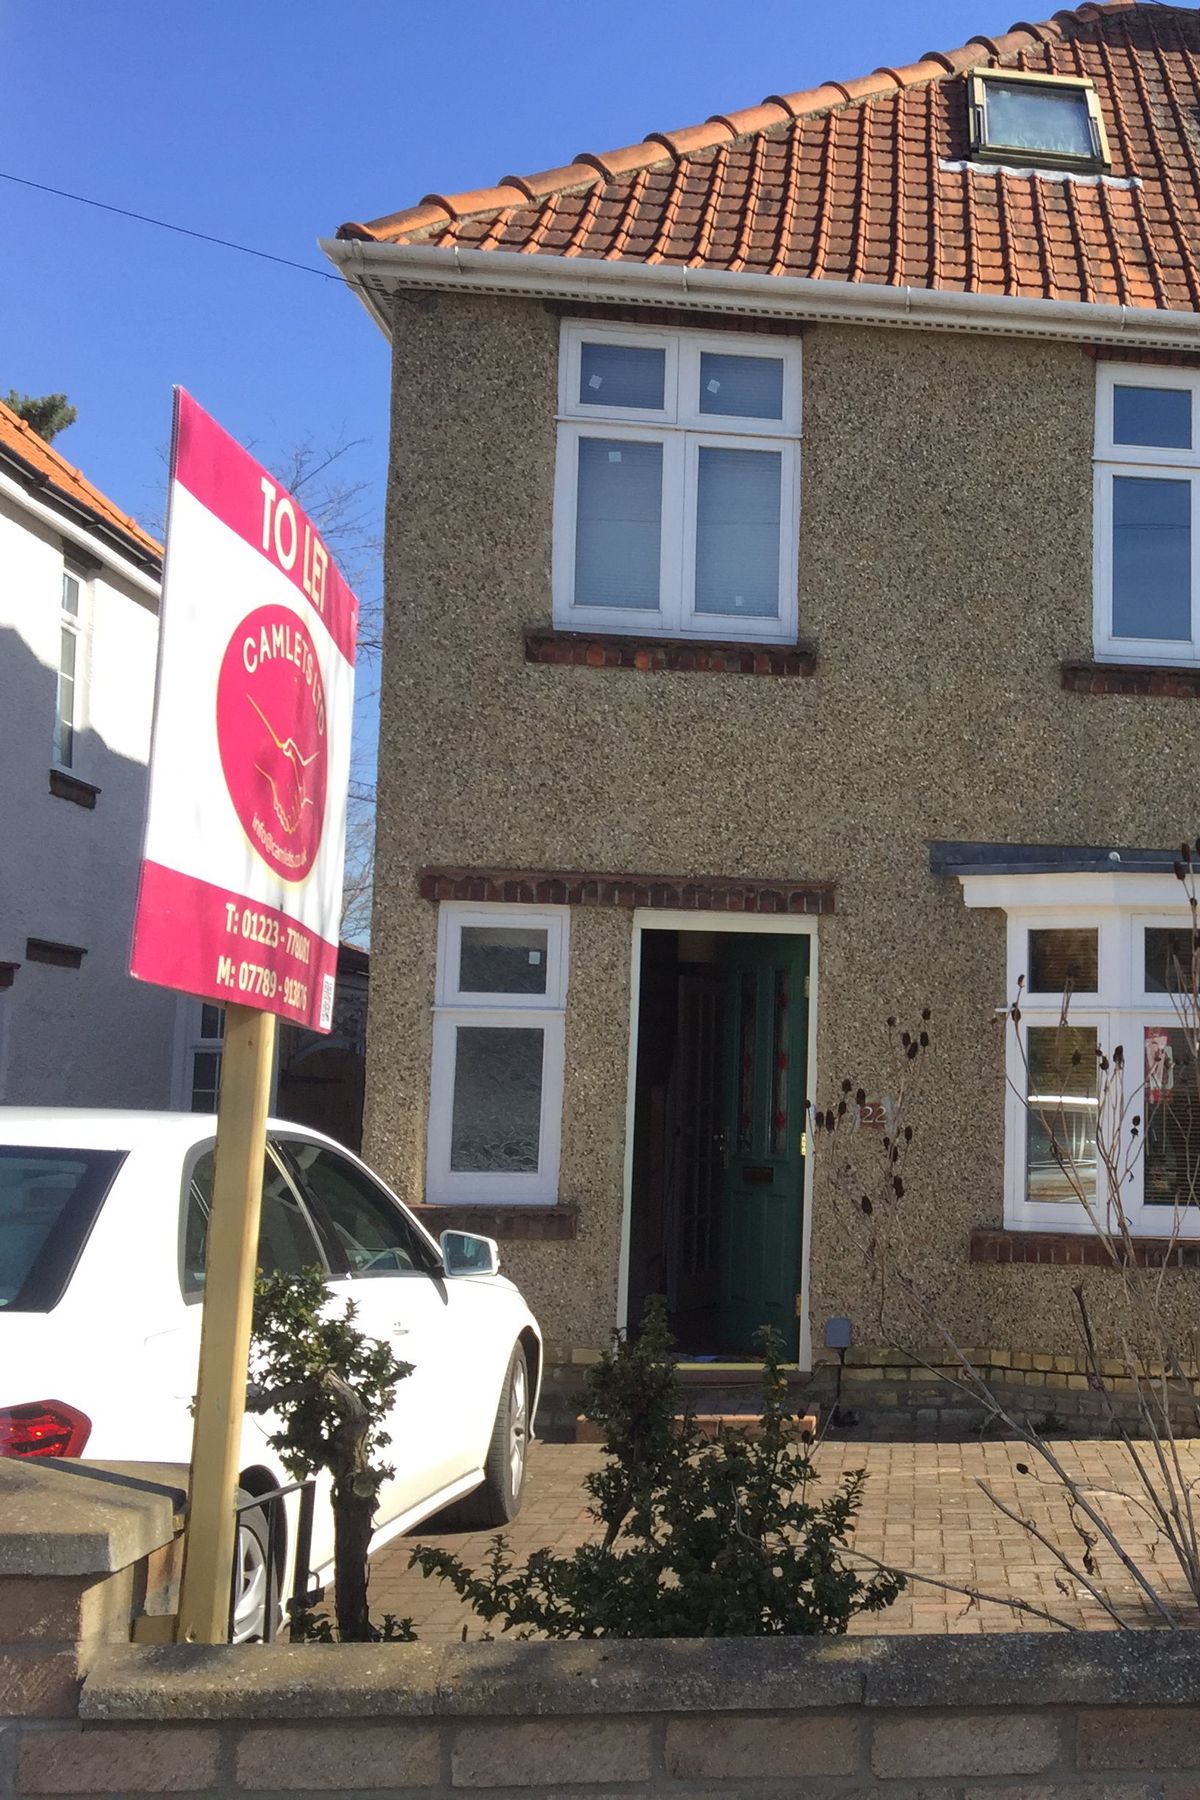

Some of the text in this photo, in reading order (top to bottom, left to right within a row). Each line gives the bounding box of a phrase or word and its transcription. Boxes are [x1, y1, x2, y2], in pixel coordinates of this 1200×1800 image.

[261, 476, 328, 614] TO LET
[243, 624, 325, 735] CAMLETS LTD
[225, 902, 239, 934] T:
[241, 909, 279, 948] 01223
[216, 955, 235, 987] M:
[238, 961, 276, 998] 07789
[862, 1105, 887, 1123] 22
